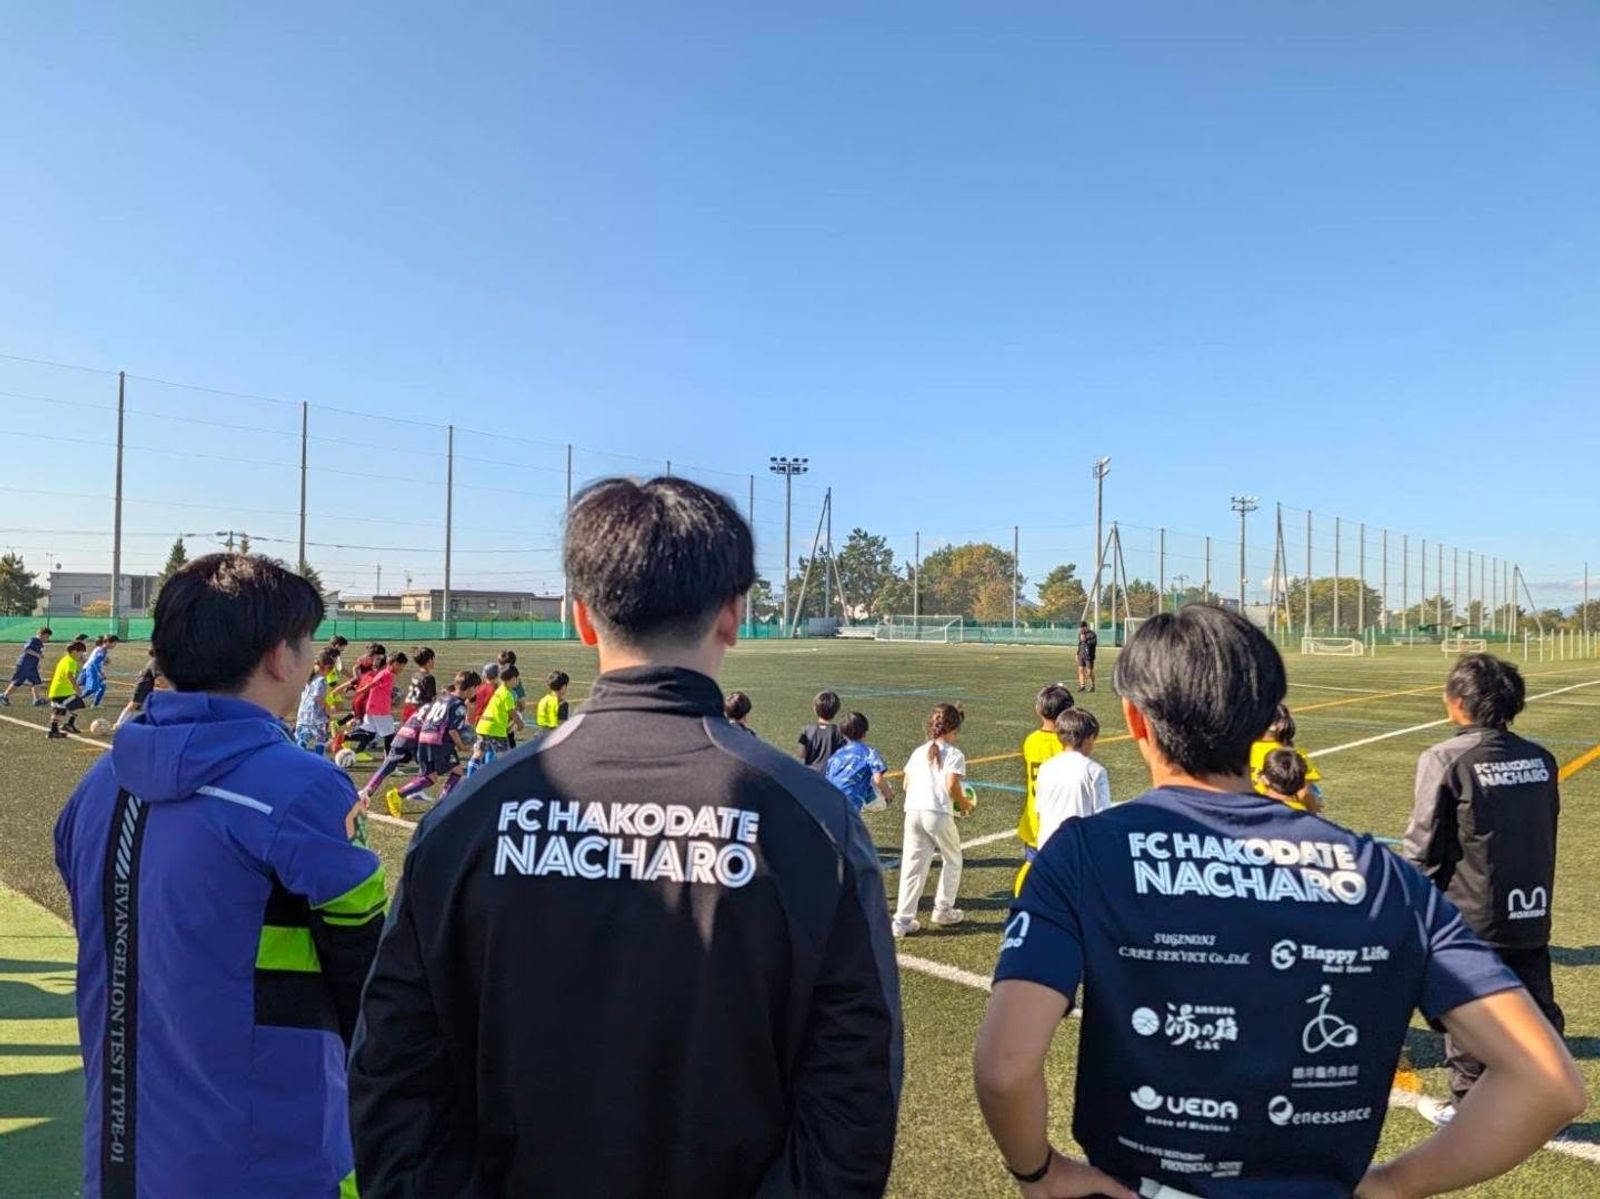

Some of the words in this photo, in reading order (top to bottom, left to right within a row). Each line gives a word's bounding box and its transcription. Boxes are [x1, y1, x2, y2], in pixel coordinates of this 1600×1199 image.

[1478, 768, 1549, 787] NACHARO
[497, 798, 541, 832] FC
[547, 800, 760, 844] HAKODATE
[494, 835, 758, 888] NACHARO
[1128, 832, 1168, 860] FC
[1173, 833, 1357, 871] HAKODATE
[1133, 861, 1367, 905] NACHARO
[110, 882, 130, 1023] EVANGELION
[1301, 944, 1358, 965] Happy
[1361, 946, 1390, 961] Life
[110, 1027, 125, 1078] TEST
[109, 1083, 125, 1163] TYPE-01
[1166, 1095, 1239, 1120] UEDA
